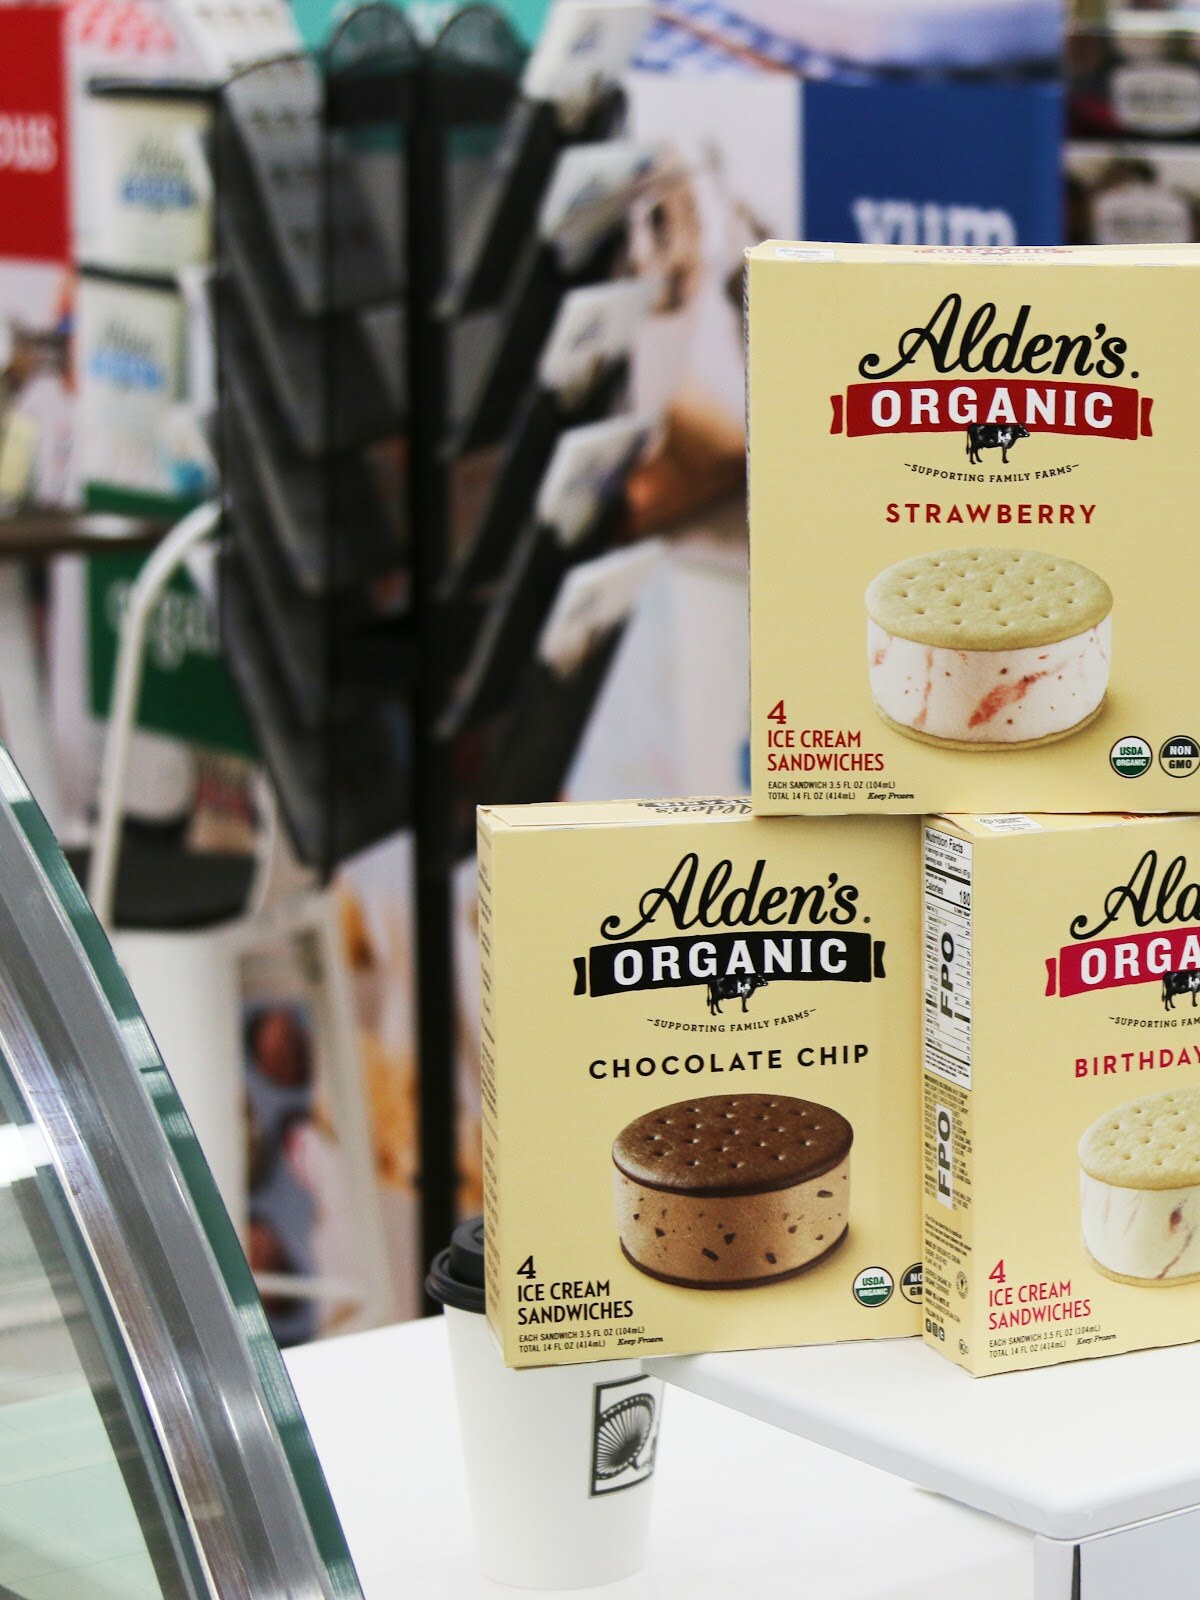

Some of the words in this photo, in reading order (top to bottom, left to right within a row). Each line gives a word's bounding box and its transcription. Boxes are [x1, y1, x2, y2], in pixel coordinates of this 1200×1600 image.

[858, 293, 1128, 380] Alden's
[871, 386, 1114, 429] ORGANIC
[989, 472, 1031, 483] FAMILY
[885, 503, 1097, 524] STRAWBERRY
[767, 700, 787, 725] 4
[768, 730, 795, 748] ICE
[800, 730, 862, 748] CREAM
[1120, 746, 1143, 756] USDA
[1169, 746, 1191, 755] NON
[767, 753, 885, 772] SANDWICHES
[1116, 759, 1146, 767] ORGANIC
[1168, 760, 1192, 769] GMO
[768, 781, 788, 789] EACH
[790, 781, 828, 789] SANDWICH
[829, 781, 841, 789] 3.5
[843, 781, 851, 789] FL
[854, 781, 863, 789] OZ
[866, 781, 896, 790] (104mL)
[768, 792, 790, 800] TOTAL
[792, 792, 801, 800] 14
[803, 792, 811, 800] FL
[814, 792, 823, 800] OZ
[825, 792, 856, 801] (414mL)
[867, 793, 886, 801] Keep
[600, 853, 859, 940] Alden's
[613, 938, 849, 986] ORGANIC
[940, 932, 955, 1019] FPO
[730, 1018, 770, 1032] FAMILY
[588, 1049, 783, 1080] CHOCOLATE
[797, 1044, 870, 1068] CHIP
[938, 1110, 951, 1197] FPO
[516, 1255, 537, 1280] 4
[910, 1273, 923, 1282] NO
[989, 1259, 1006, 1283] 4
[517, 1283, 545, 1303] ICE
[549, 1279, 611, 1300] CREAM
[862, 1277, 885, 1286] USDA
[910, 1287, 923, 1296] GM
[989, 1287, 1013, 1307] ICE
[1018, 1280, 1071, 1303] CREAM
[517, 1300, 634, 1326] SANDWICHES
[989, 1299, 1091, 1330] SANDWICHES
[519, 1334, 538, 1342] EACH
[540, 1331, 578, 1341] SANDWICH
[580, 1330, 591, 1338] 3.5
[616, 1326, 645, 1336] (104mL)
[989, 1339, 1006, 1347] EACH
[1008, 1334, 1041, 1345] SANDWICH
[1043, 1332, 1053, 1340] 3.5
[1055, 1330, 1063, 1338] FL
[1065, 1329, 1073, 1337] OZ
[1075, 1324, 1101, 1335] (104mL)
[519, 1344, 540, 1353] TOTAL
[554, 1342, 562, 1350] FL
[564, 1342, 573, 1350] OZ
[576, 1340, 606, 1349] (414mL)
[617, 1338, 636, 1346] Keep
[637, 1336, 664, 1344] Frozen
[990, 1349, 1008, 1358] TOTAL
[1011, 1347, 1018, 1355] 14
[1021, 1346, 1028, 1354] FL
[1040, 1340, 1067, 1351] (414mL)
